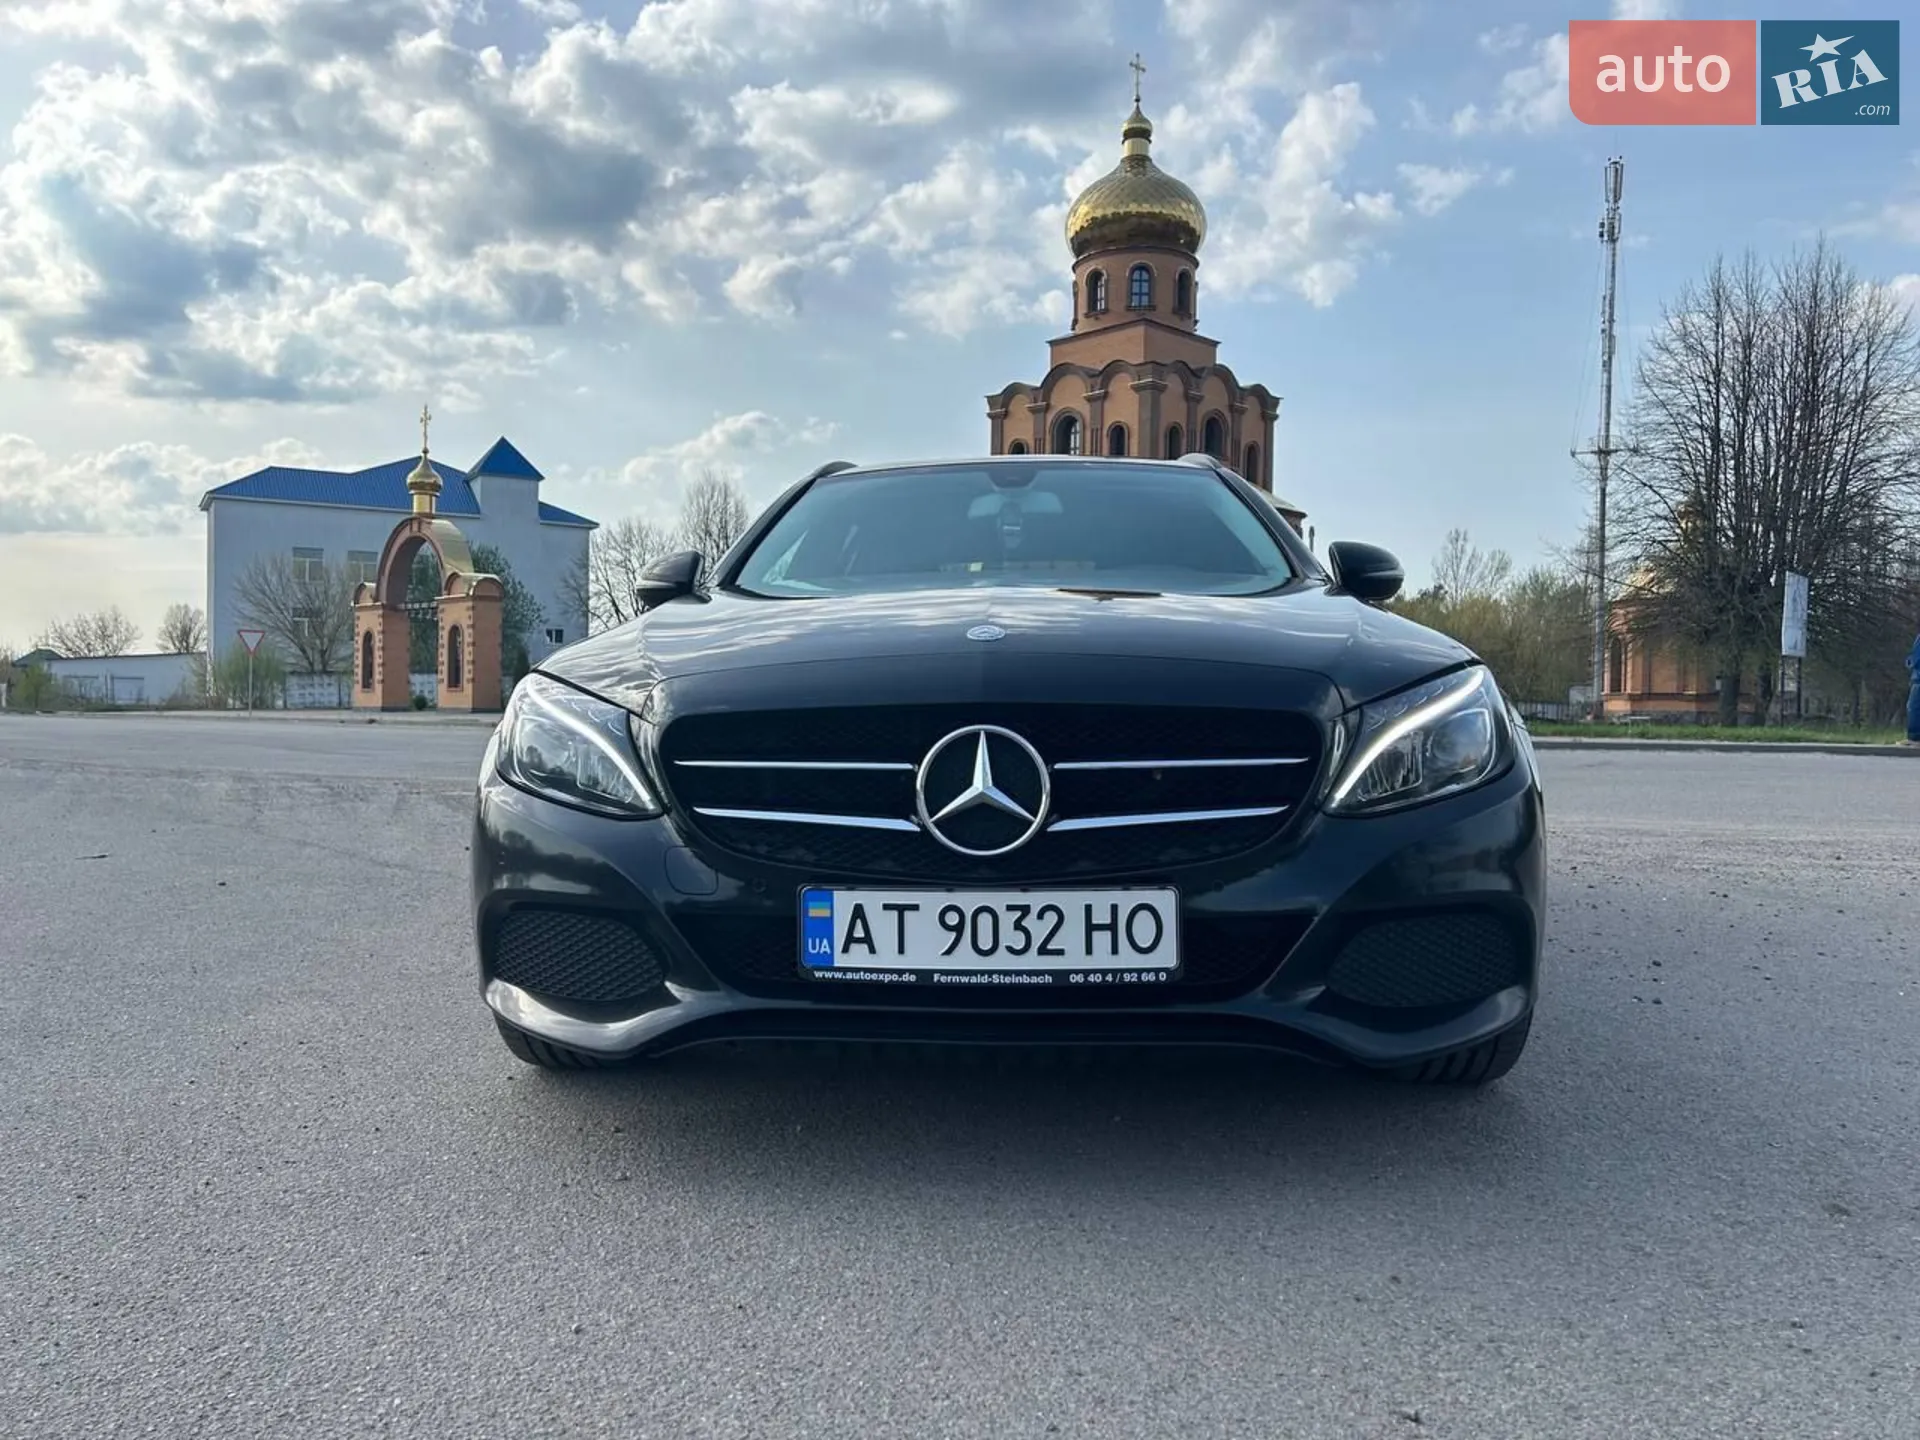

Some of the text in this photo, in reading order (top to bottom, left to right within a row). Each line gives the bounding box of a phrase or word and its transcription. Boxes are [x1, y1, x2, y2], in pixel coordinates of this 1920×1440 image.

[840, 902, 1164, 957] AT 9032 HO
[807, 936, 831, 954] UA
[813, 969, 917, 982] www.autoexpo.de
[933, 972, 1053, 984] Fernwald-Steinbach
